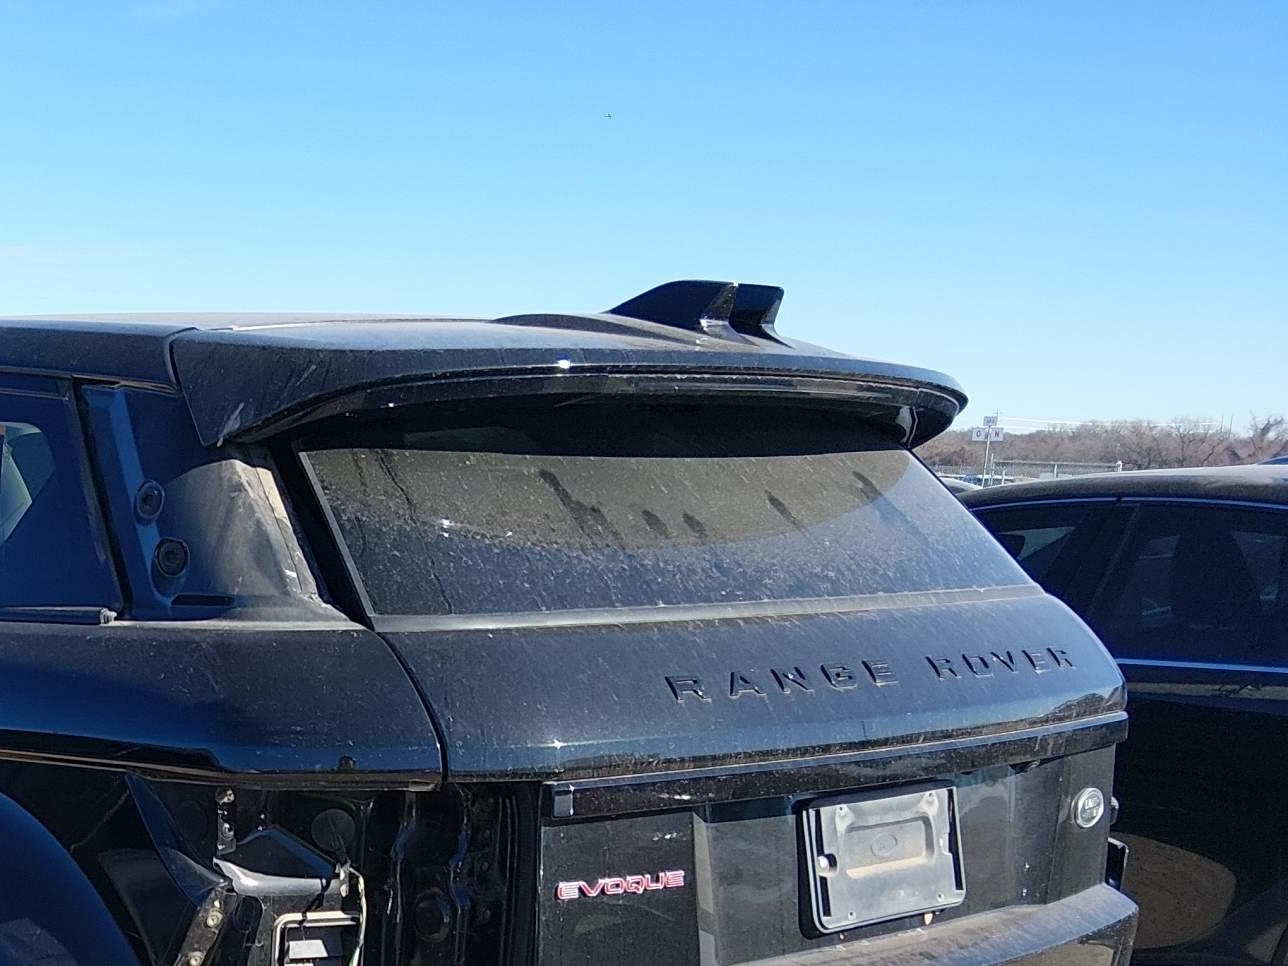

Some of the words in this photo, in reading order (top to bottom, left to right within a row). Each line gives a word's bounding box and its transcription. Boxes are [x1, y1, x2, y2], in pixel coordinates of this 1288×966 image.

[664, 659, 900, 703] RANGE
[925, 647, 1077, 680] ROVER
[557, 869, 685, 900] EVOQUE
